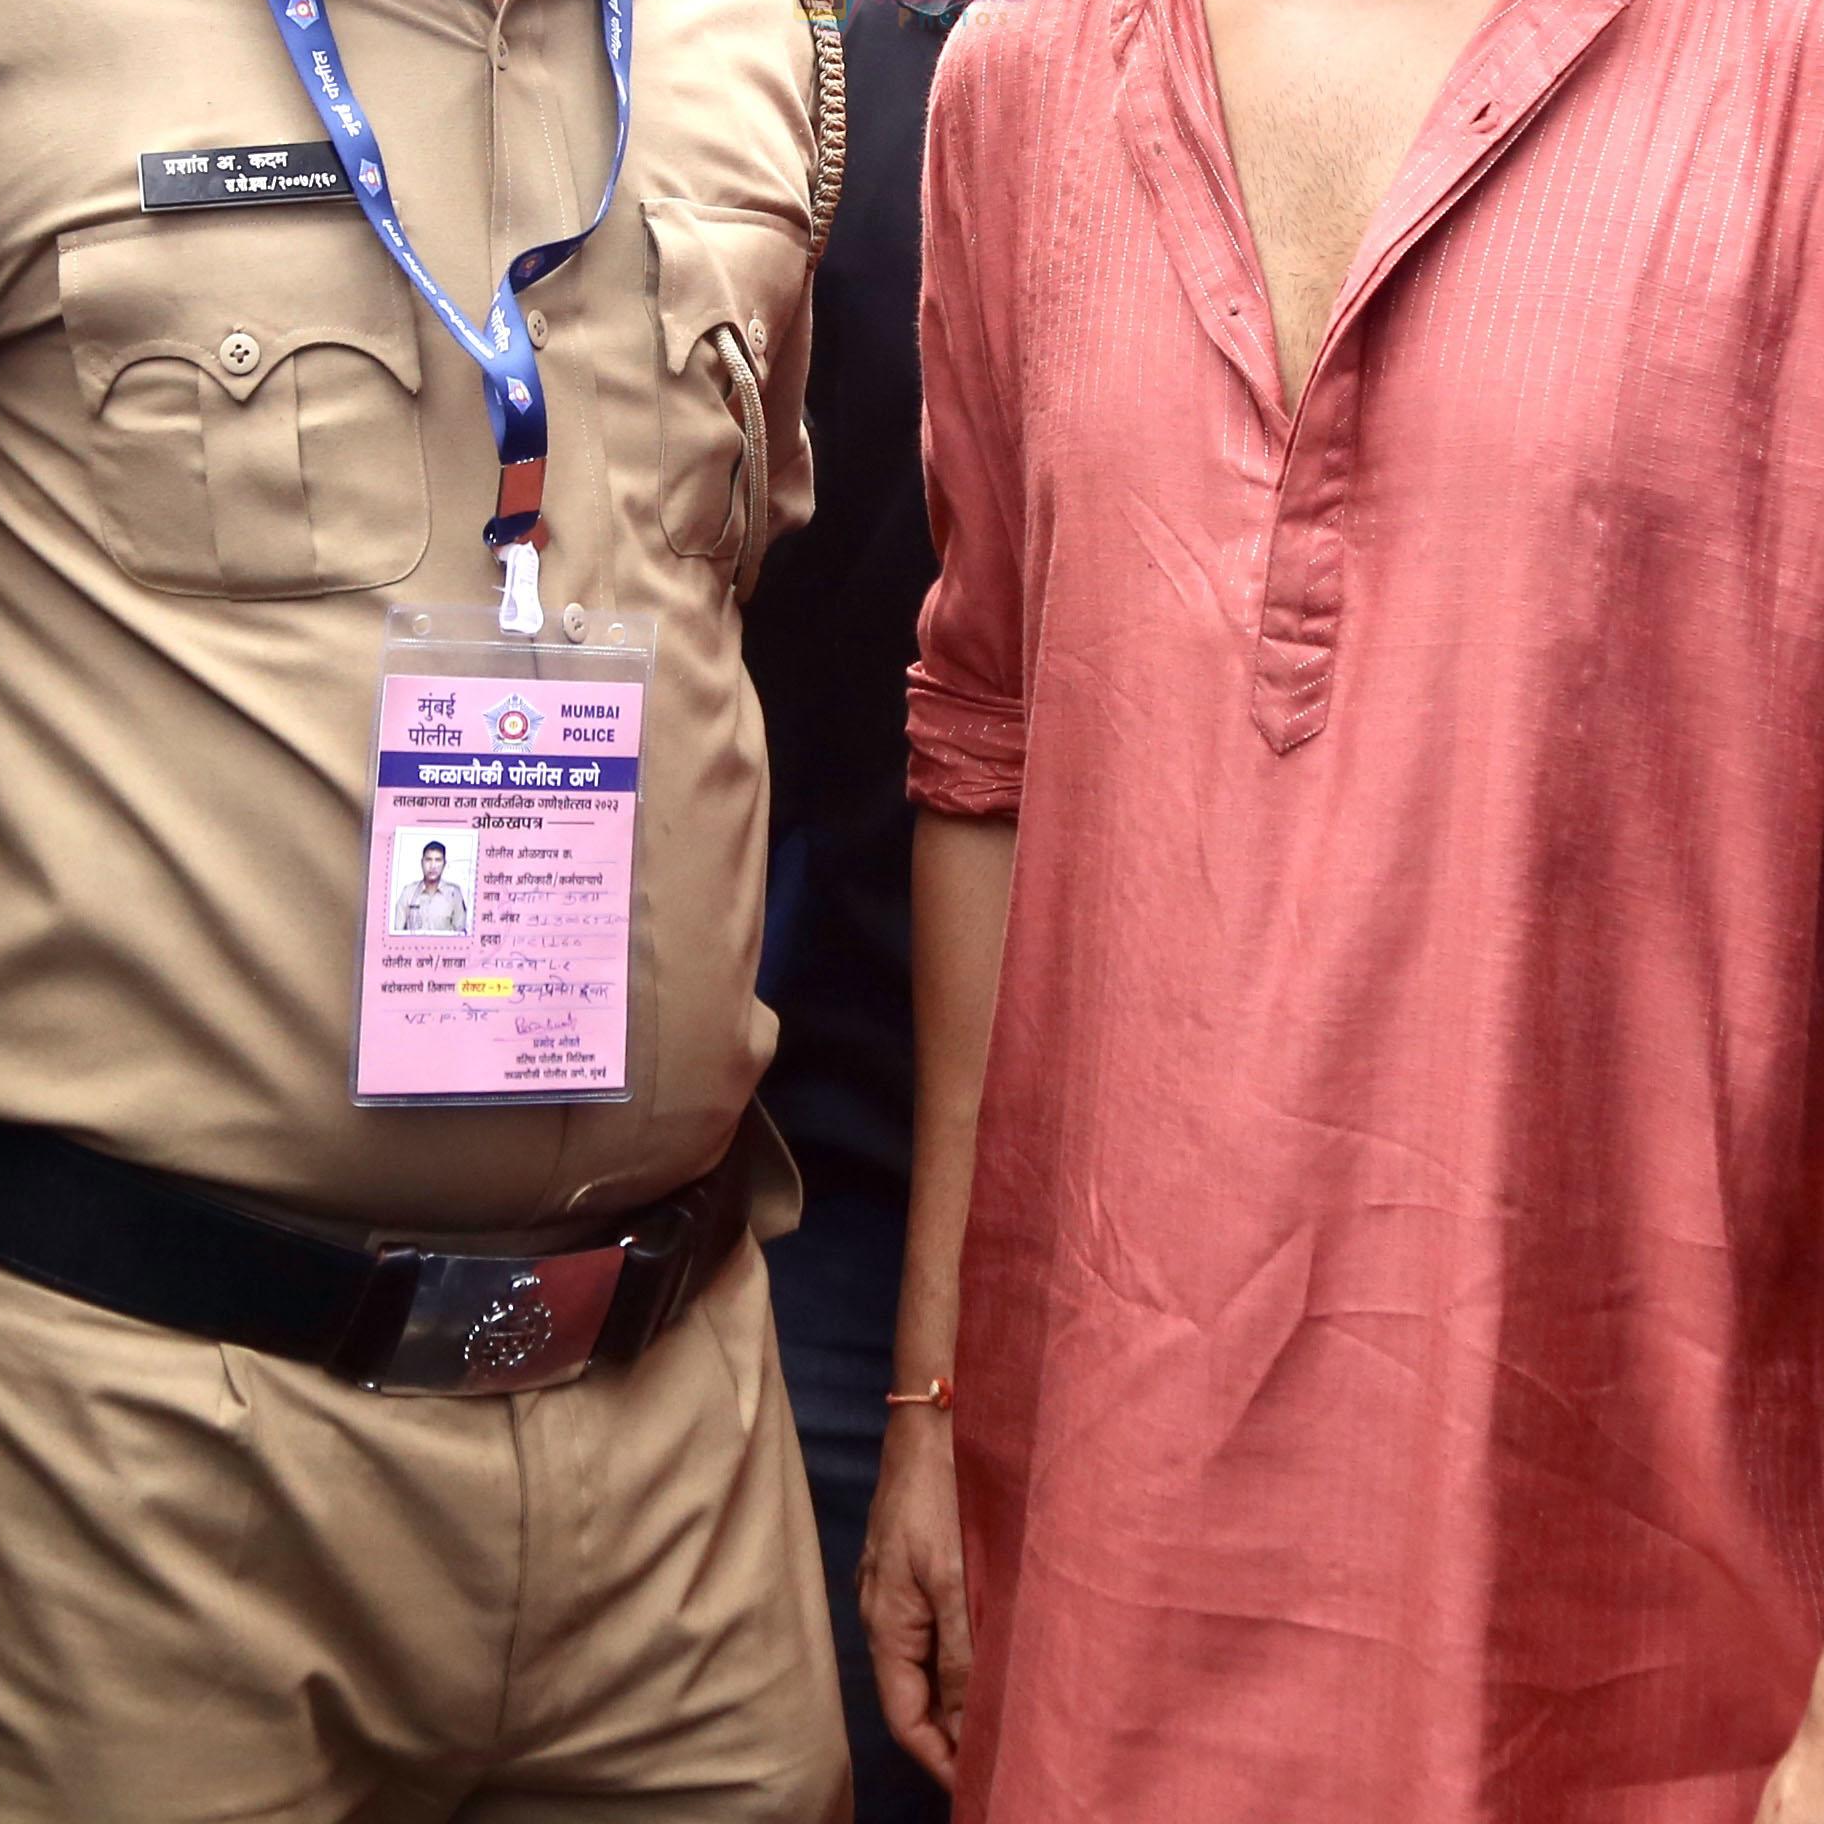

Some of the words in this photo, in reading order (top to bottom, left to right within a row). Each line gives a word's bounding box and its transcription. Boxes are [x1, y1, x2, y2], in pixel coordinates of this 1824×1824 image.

[311, 49, 341, 100] पोलीस
[330, 103, 363, 137] मुंबई
[163, 154, 210, 175] प्रशांत
[216, 155, 242, 171] अ.
[247, 151, 288, 169] कदम
[417, 692, 456, 721] मुंबई
[561, 704, 620, 719] MUMBAI
[408, 722, 463, 747] पोलीस
[563, 727, 616, 742] POLICE
[418, 758, 503, 785] काळाचौकी
[508, 760, 563, 787] पोलीस
[568, 762, 600, 787] ठाणे
[393, 795, 450, 808] लालबागचा
[454, 796, 478, 809] राजा
[481, 793, 535, 809] सार्वजनिक
[537, 795, 592, 810] गणेशोत्सव
[595, 799, 619, 813] २०२३
[471, 813, 543, 830] ओळखपत्र
[485, 845, 514, 859] पोलीस
[517, 845, 559, 859] ओळखपत्र
[483, 871, 513, 885] पोलीस
[483, 892, 500, 902] नाव
[481, 910, 496, 923] मो.
[499, 913, 520, 924] नंबर
[382, 955, 412, 968] पोलीस
[427, 980, 456, 993] ठिकाण
[461, 980, 486, 993] सेक्टर
[538, 1052, 563, 1064] पोलीस
[543, 1067, 567, 1079] पोलीस
[589, 1066, 607, 1080] मुंबई
